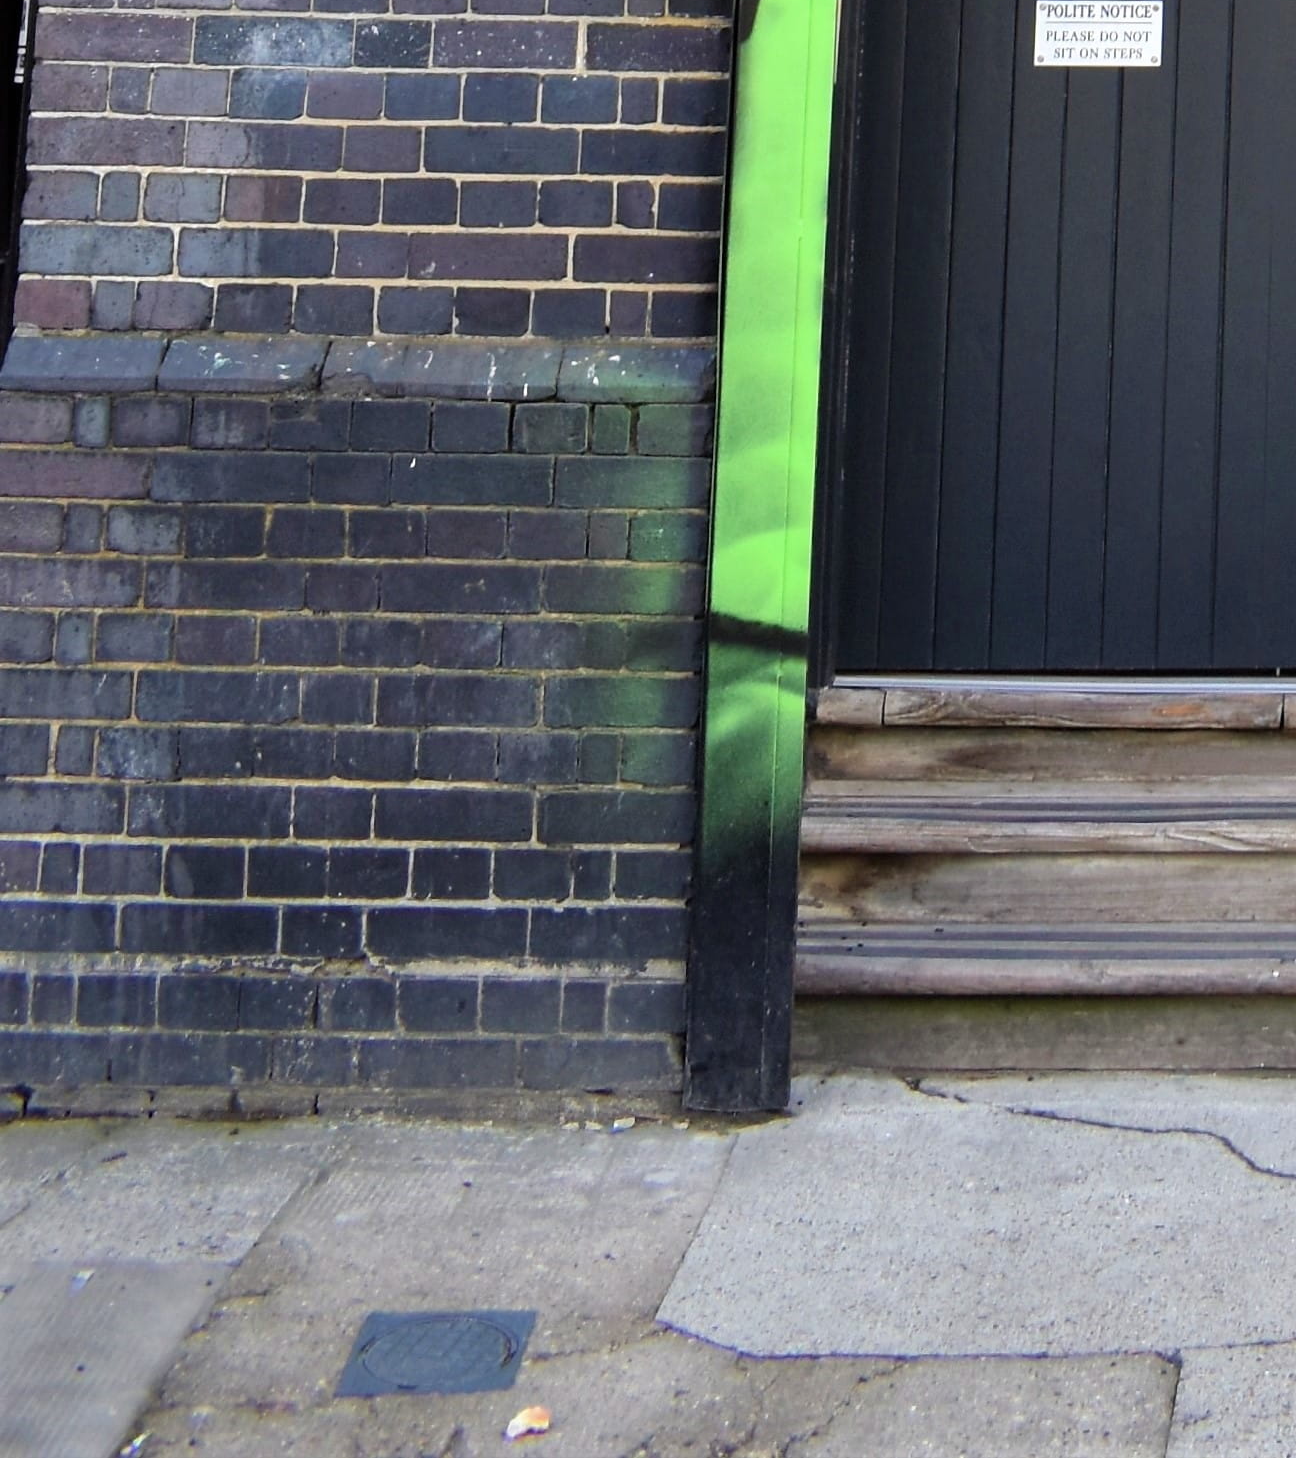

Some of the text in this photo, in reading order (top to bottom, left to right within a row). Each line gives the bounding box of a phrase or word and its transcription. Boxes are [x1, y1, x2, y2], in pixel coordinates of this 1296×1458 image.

[1046, 4, 1153, 19] POLITE NOTICE
[1046, 30, 1152, 42] PLEASE DO NOT
[1053, 47, 1143, 59] SIT ON STEPS
